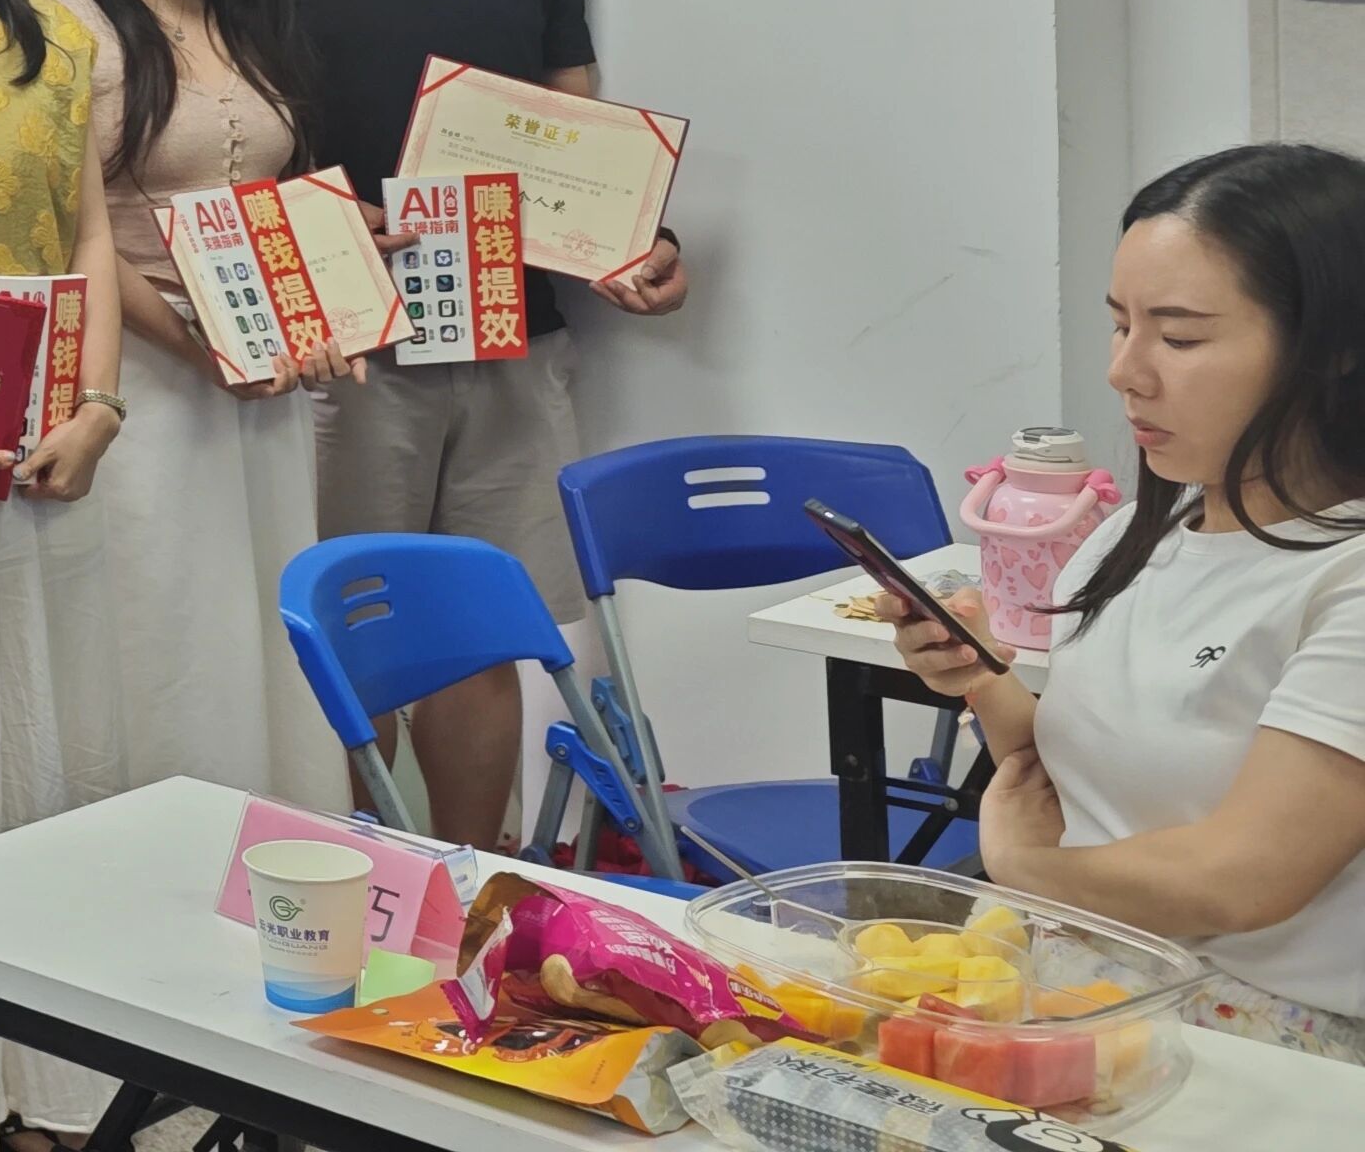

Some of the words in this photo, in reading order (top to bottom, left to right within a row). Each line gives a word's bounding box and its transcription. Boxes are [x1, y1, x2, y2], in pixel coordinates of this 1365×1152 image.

[505, 113, 581, 145] 荣誉证书
[195, 199, 225, 236] AI
[399, 186, 440, 220] AI
[399, 219, 459, 235] 实操指南
[241, 188, 327, 361] 赚钱提效
[472, 182, 522, 349] 赚钱提效
